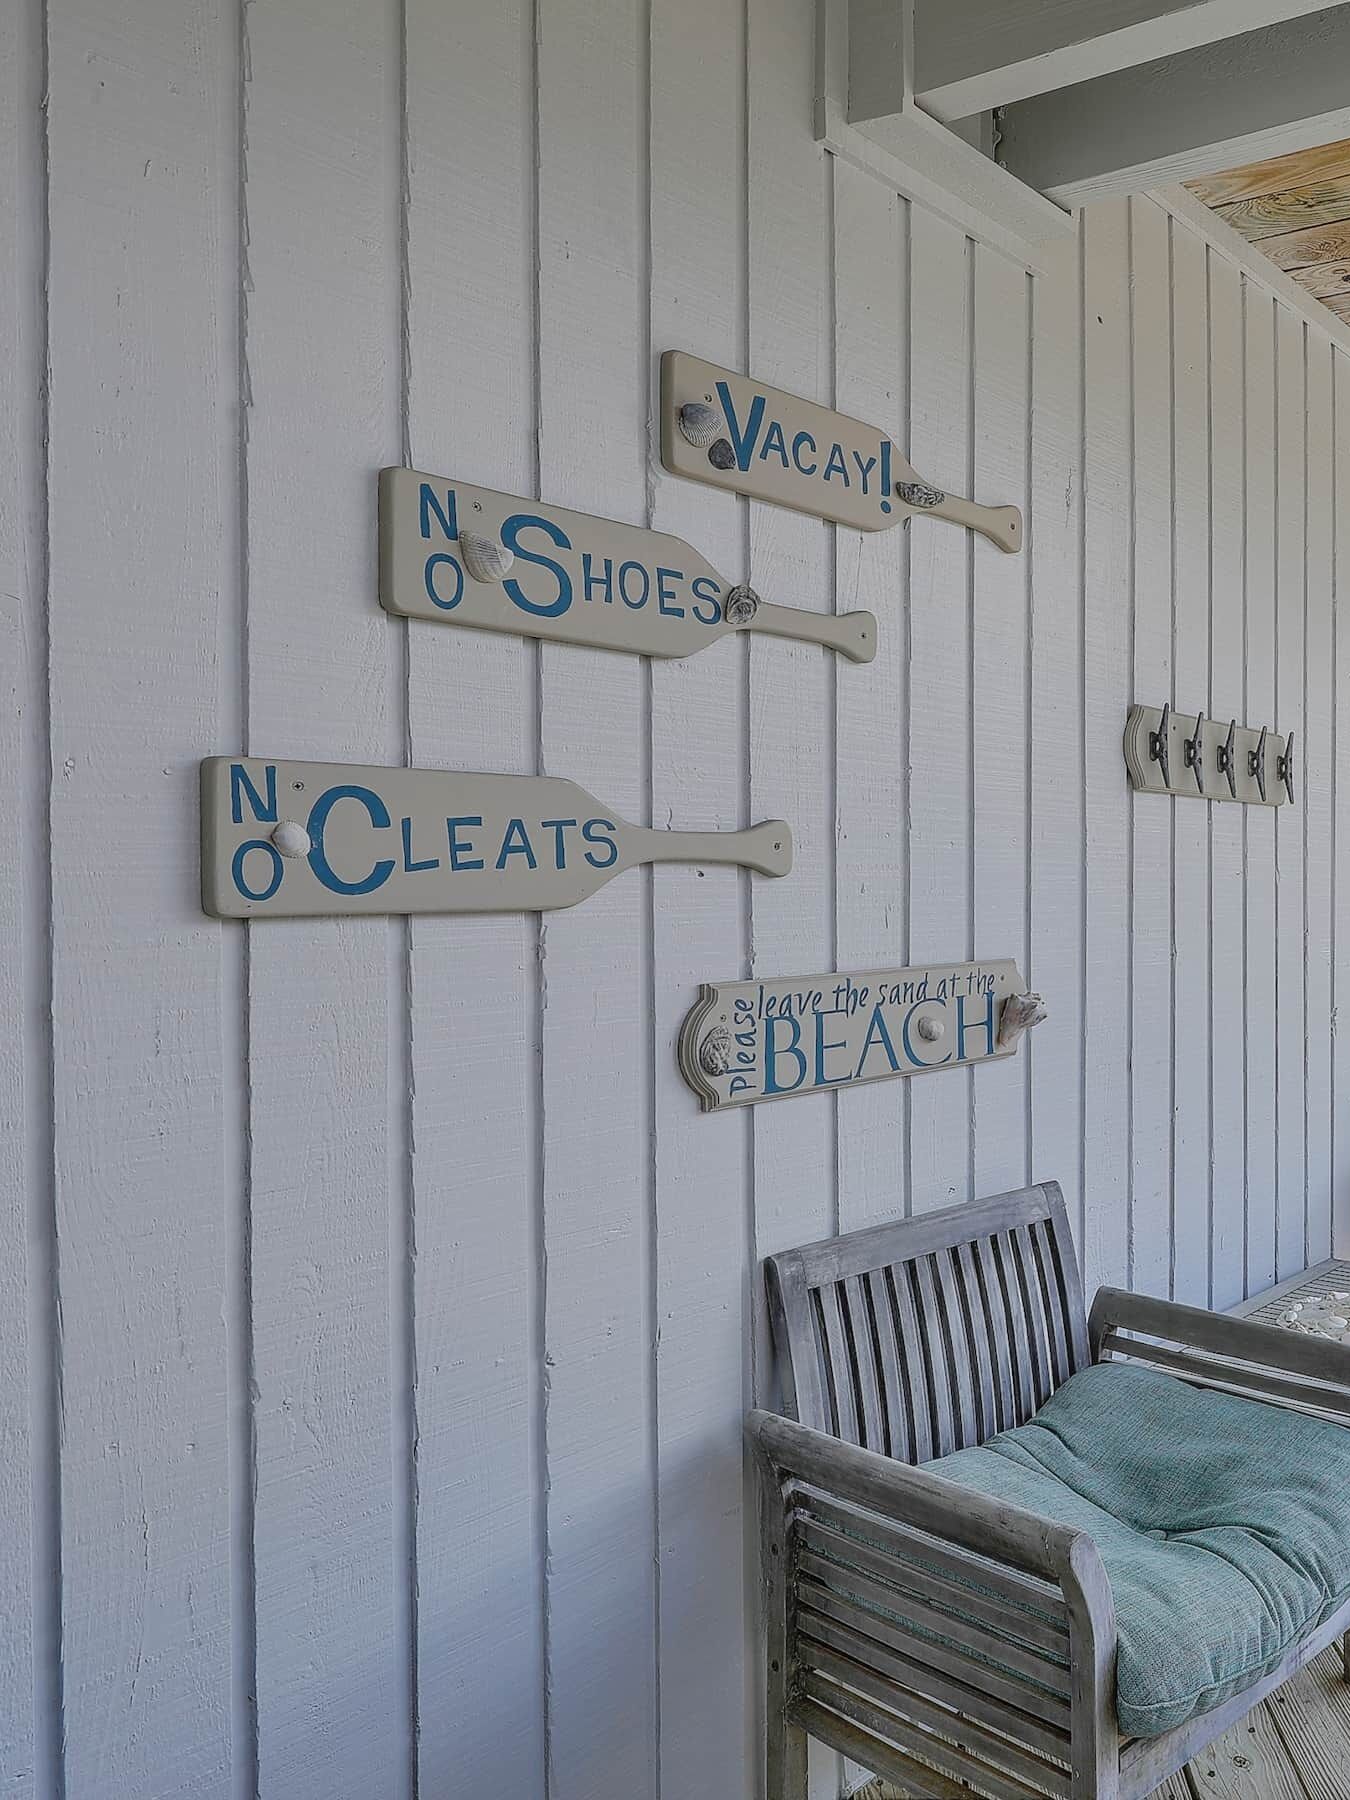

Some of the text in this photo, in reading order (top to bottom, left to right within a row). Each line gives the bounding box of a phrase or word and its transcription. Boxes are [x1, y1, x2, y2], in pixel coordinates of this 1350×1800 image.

[715, 381, 891, 513] VACAY!
[500, 514, 722, 625] SHOES
[307, 785, 618, 896] CLEATS
[757, 967, 995, 1020] leave the sand at the
[761, 991, 997, 1096] BEACH
